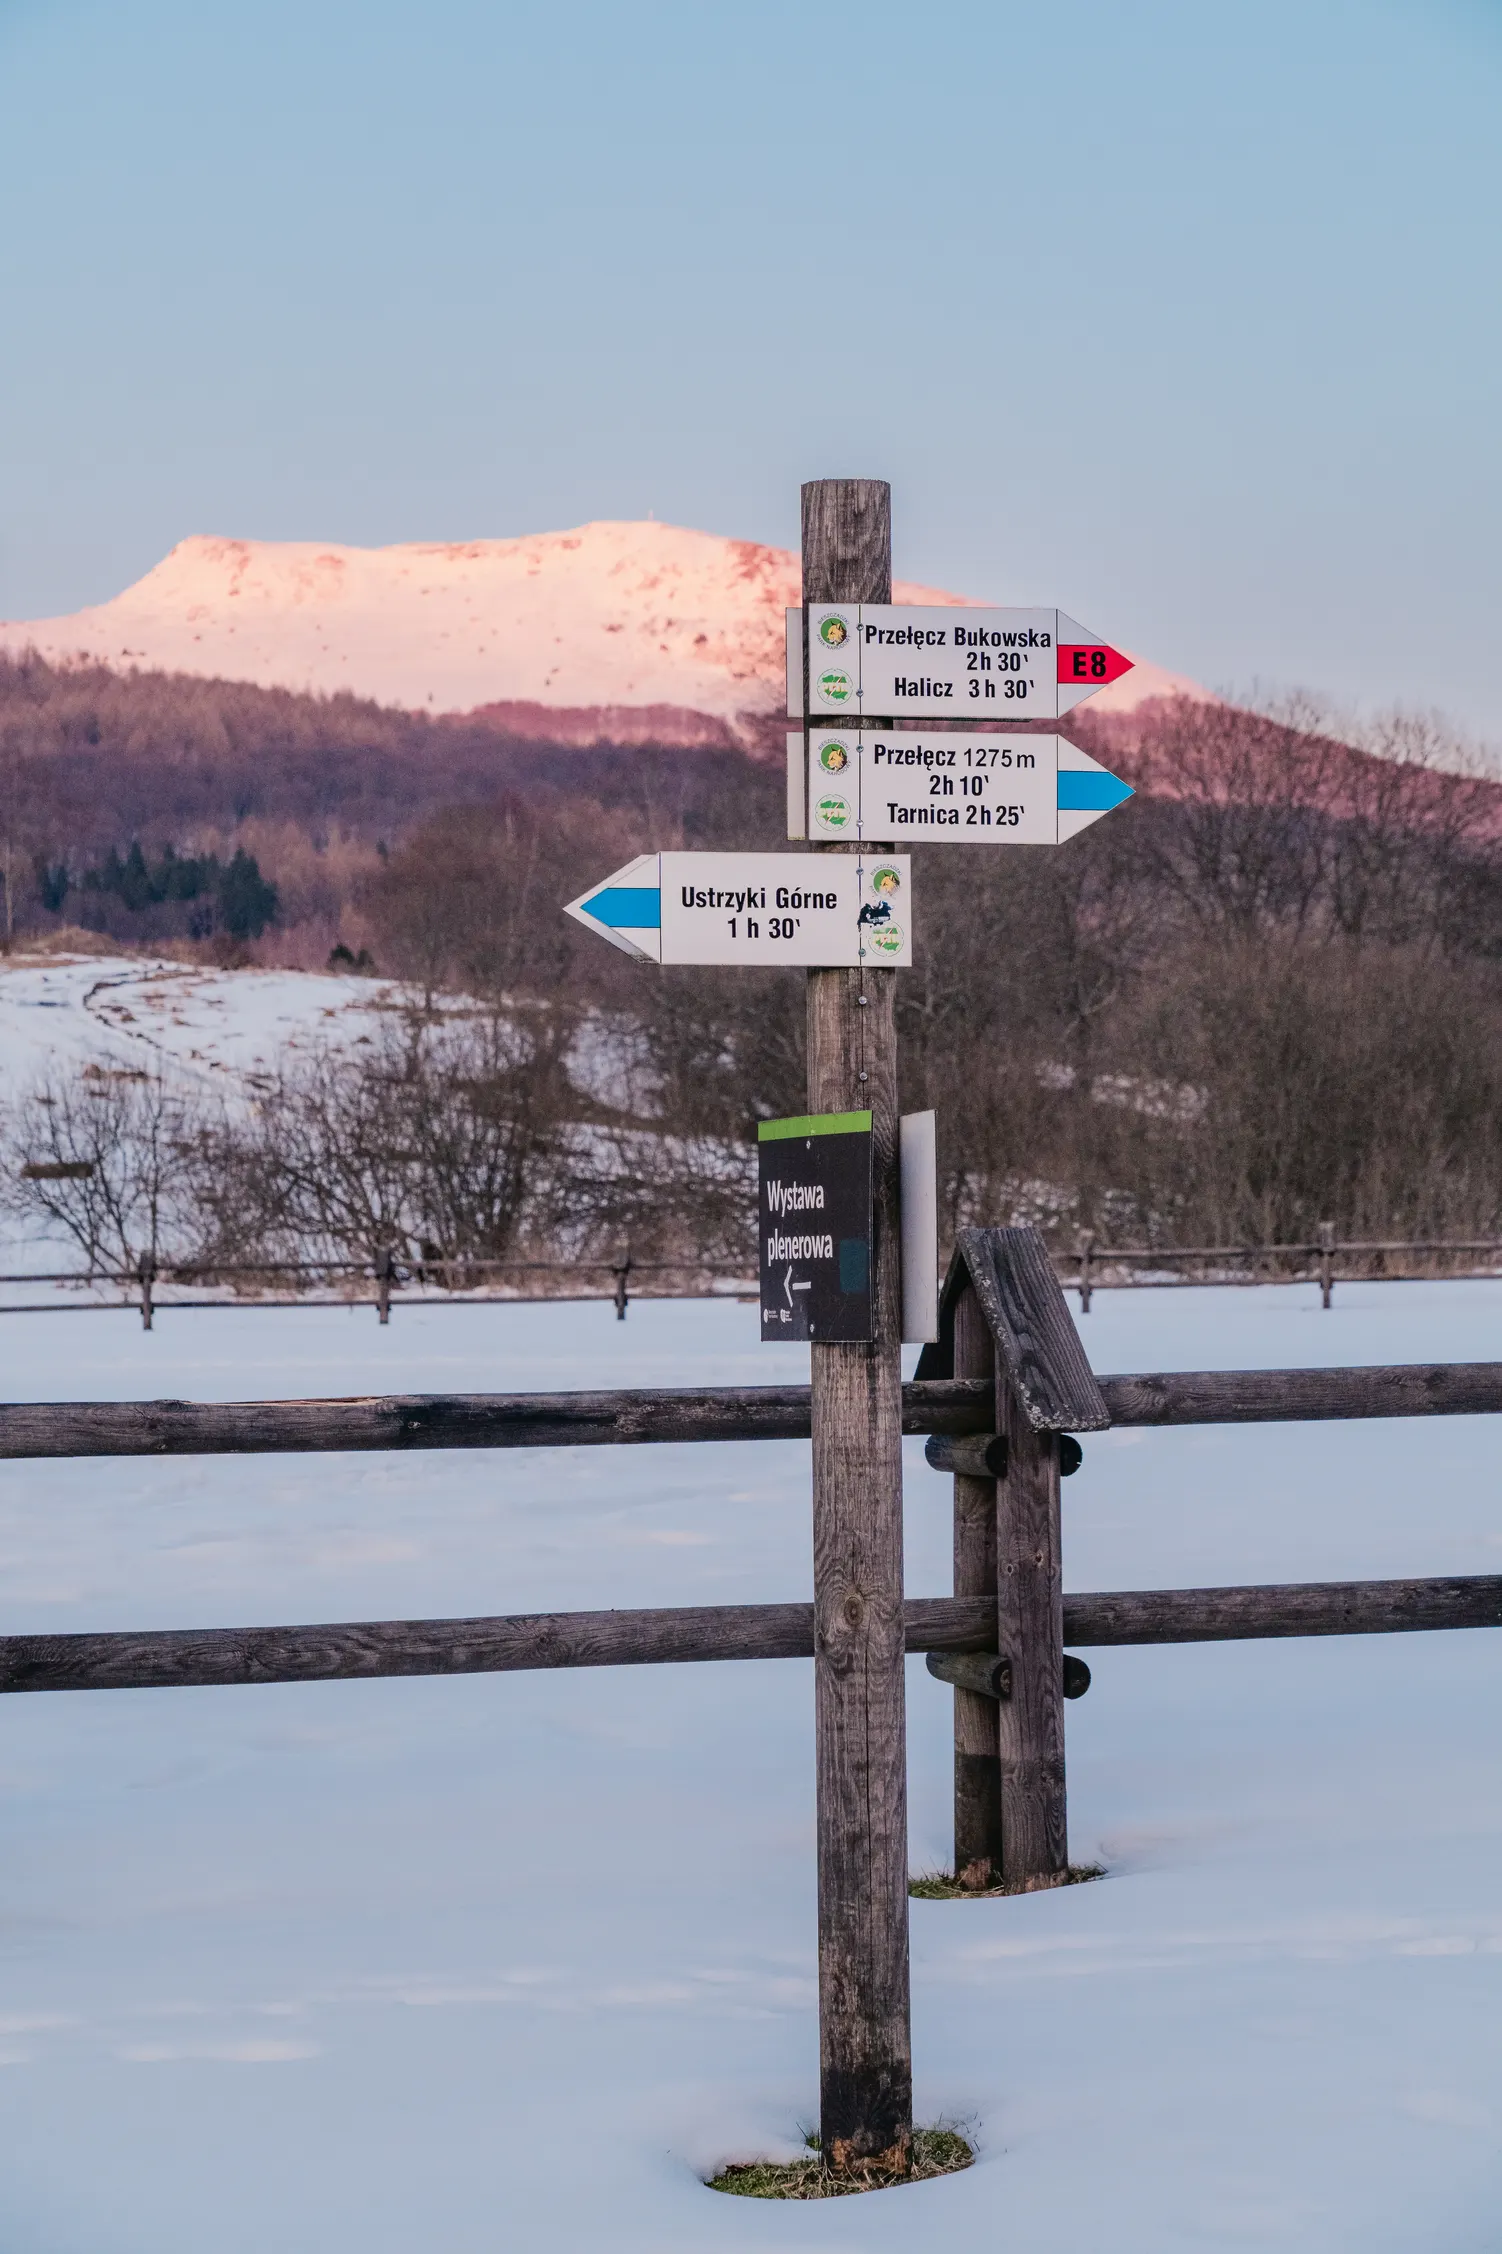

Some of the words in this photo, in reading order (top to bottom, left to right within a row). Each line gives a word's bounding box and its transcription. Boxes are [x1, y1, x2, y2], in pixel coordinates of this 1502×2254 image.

[865, 624, 946, 650] Przełęcz
[954, 626, 1051, 648] Bukowska
[1073, 651, 1107, 678] E8
[894, 677, 953, 698] Halicz
[874, 743, 956, 772] Przełęcz
[886, 802, 960, 825] Tarnica
[681, 886, 766, 913] Ustrzyki
[775, 886, 837, 910] Górne
[766, 1180, 825, 1218] Wystawa
[767, 1228, 834, 1267] plenerowa
